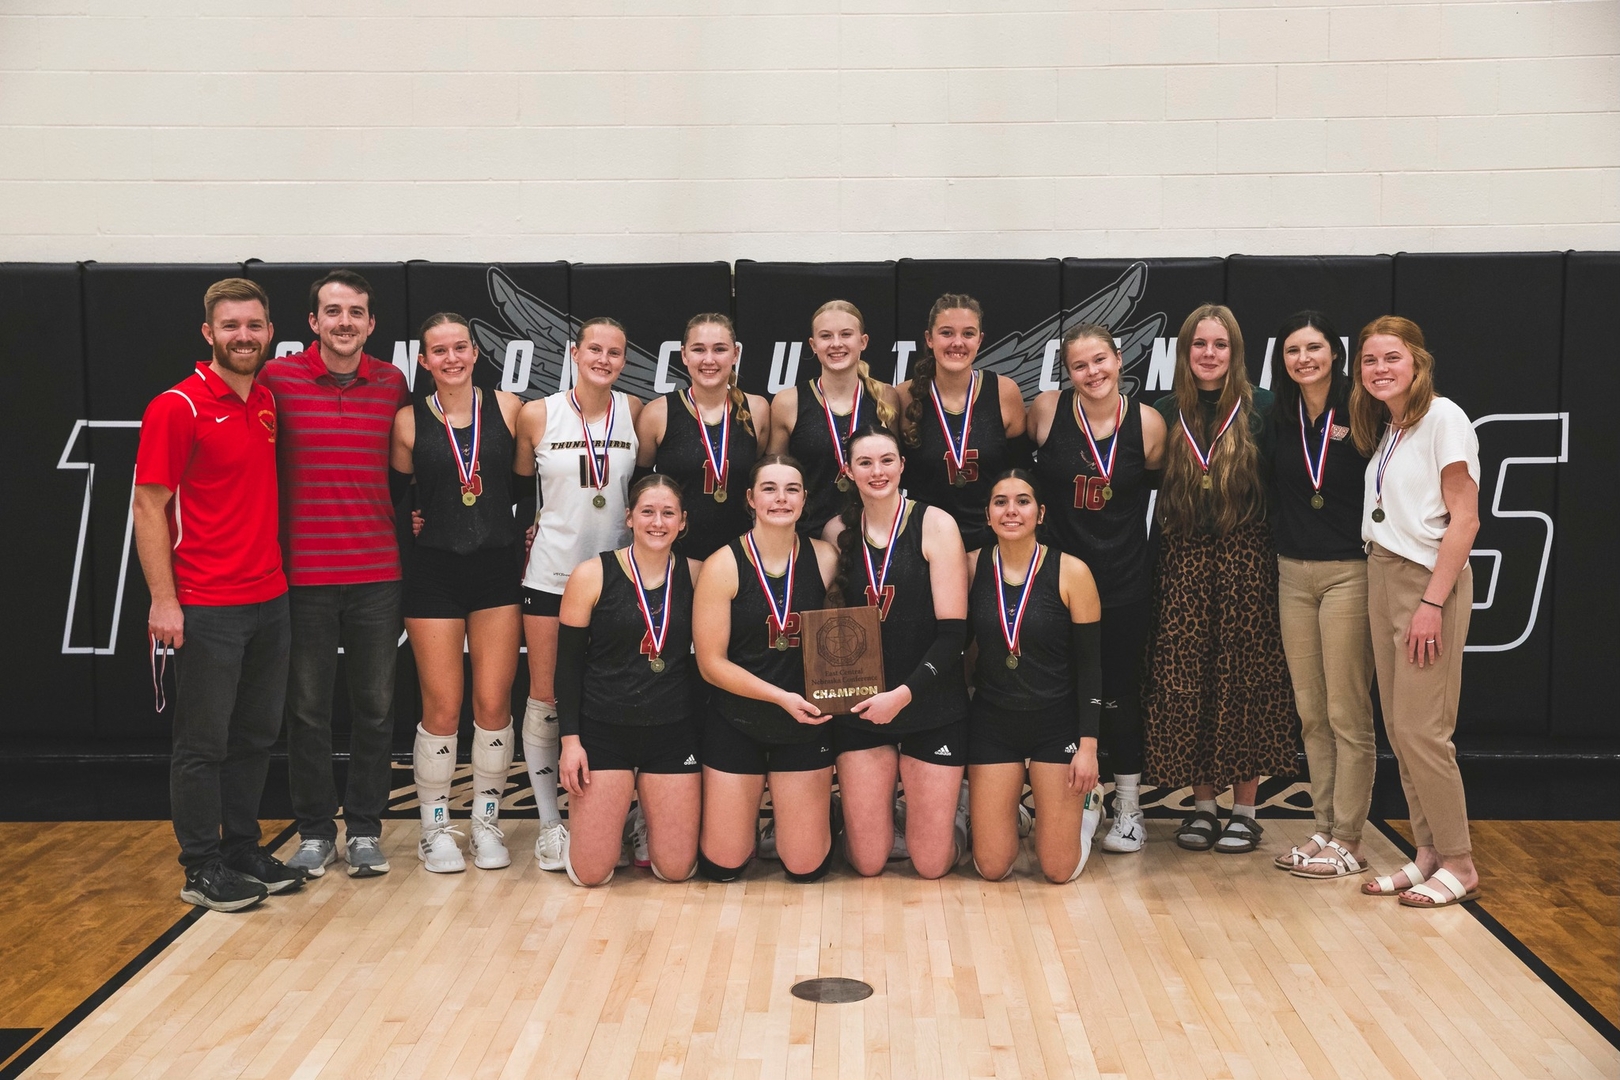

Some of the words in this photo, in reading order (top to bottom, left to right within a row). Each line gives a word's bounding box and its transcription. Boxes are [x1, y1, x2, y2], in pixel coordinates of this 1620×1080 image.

[550, 440, 632, 451] THUNDRIRDS
[943, 449, 979, 485] 15
[1073, 474, 1108, 510] 16
[864, 584, 895, 622] 17
[765, 612, 801, 648] 12
[813, 685, 878, 699] CHAMPION
